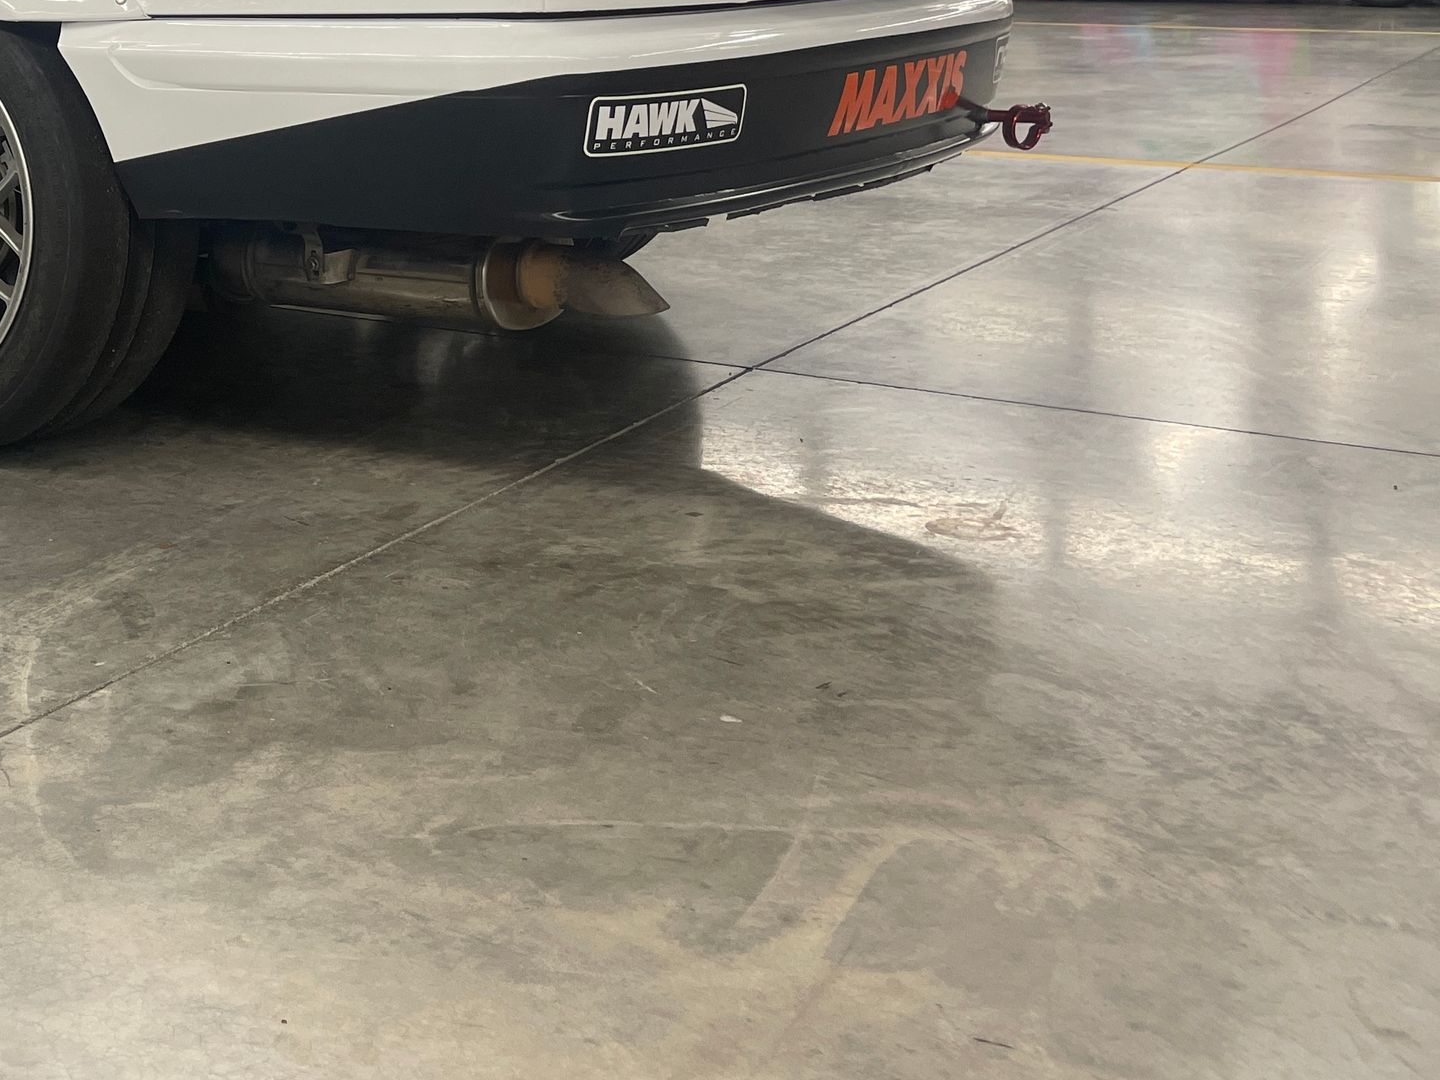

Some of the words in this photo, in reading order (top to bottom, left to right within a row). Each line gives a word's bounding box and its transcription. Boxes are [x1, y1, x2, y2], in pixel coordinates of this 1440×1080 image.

[827, 50, 968, 137] MAXXIS
[593, 127, 736, 151] PERFORMANCE
[594, 98, 701, 141] HAWK
